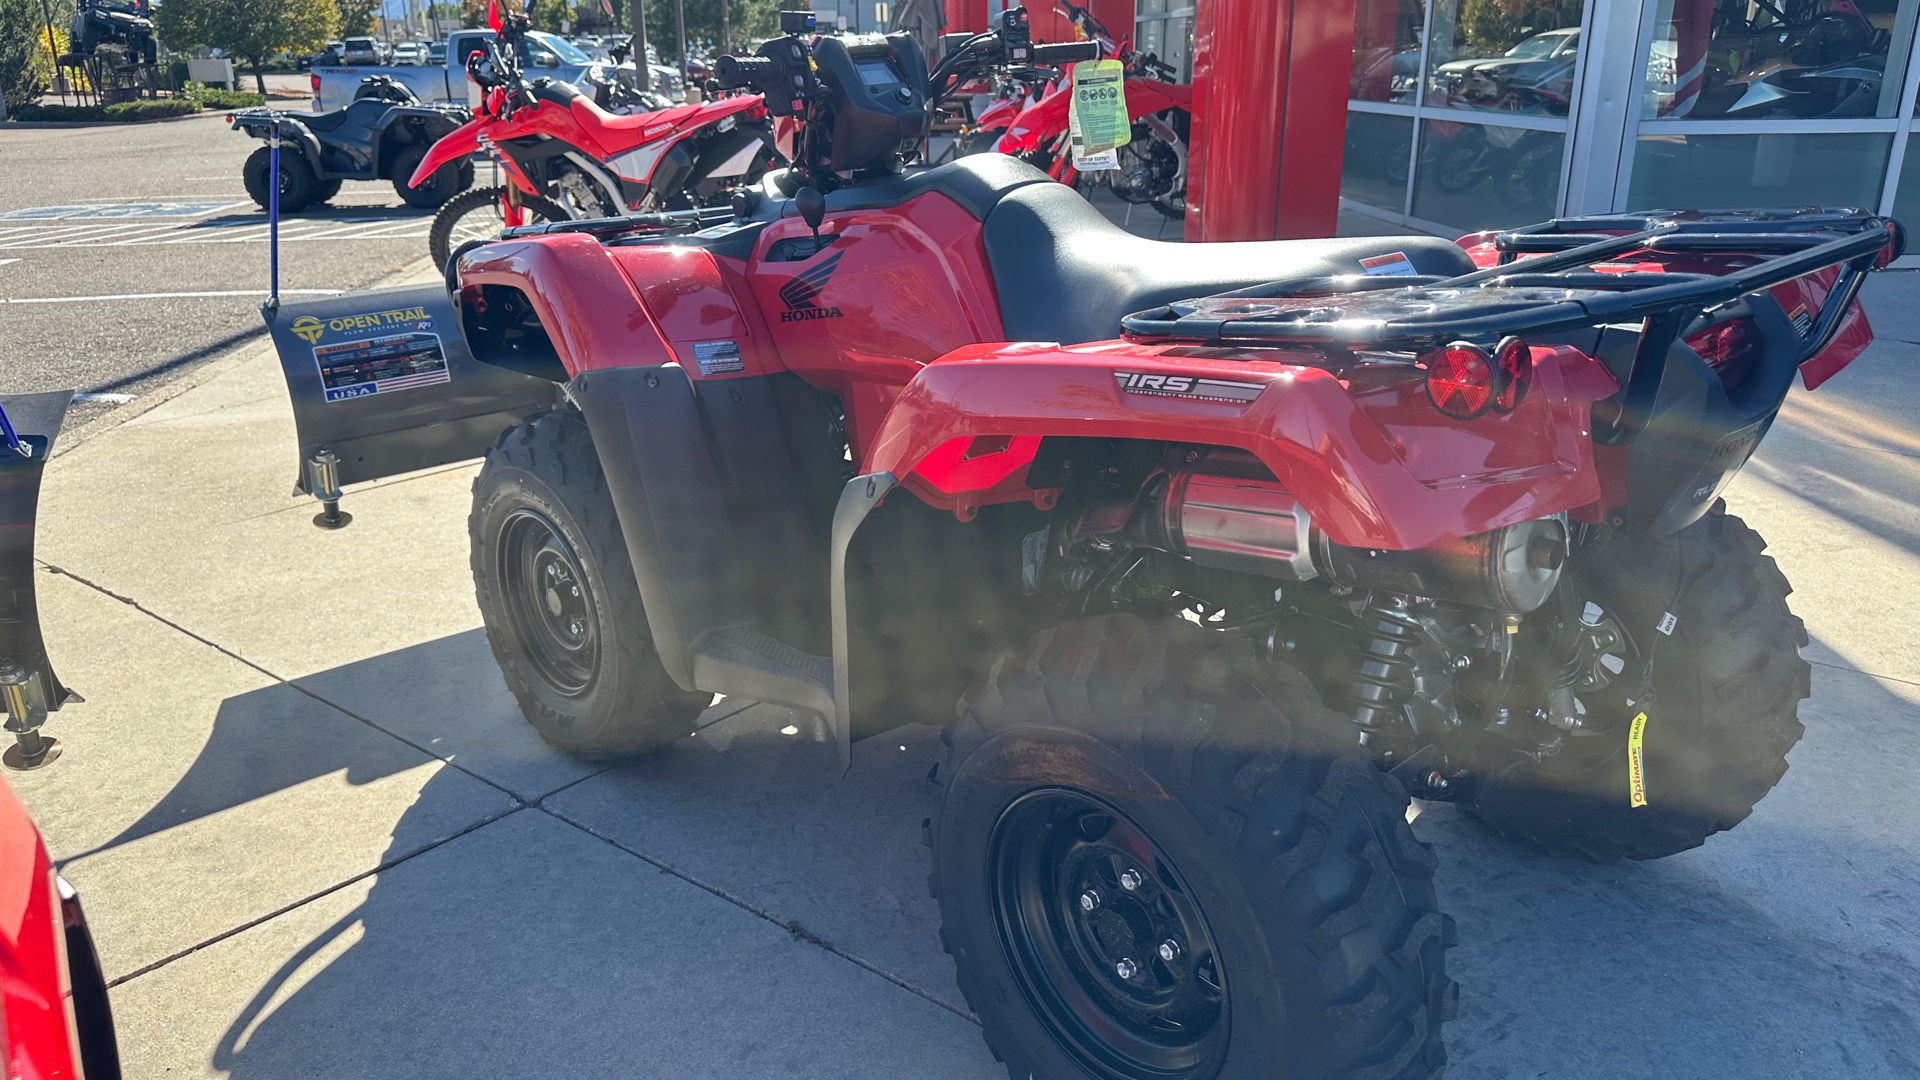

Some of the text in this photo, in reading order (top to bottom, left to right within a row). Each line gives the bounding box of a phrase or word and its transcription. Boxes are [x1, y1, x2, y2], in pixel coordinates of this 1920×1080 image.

[643, 122, 674, 137] HONDA
[329, 307, 432, 331] OPEN TRAIL
[780, 307, 844, 323] HONDA
[367, 324, 400, 332] SYSTEMS
[326, 343, 361, 353] WARNING
[1127, 374, 1193, 392] IRS
[333, 387, 371, 400] USA
[1126, 389, 1176, 398] INDEPENDENT
[1199, 395, 1247, 404] SUSPENSION
[1709, 429, 1758, 460] HOND
[1633, 717, 1642, 740] READY
